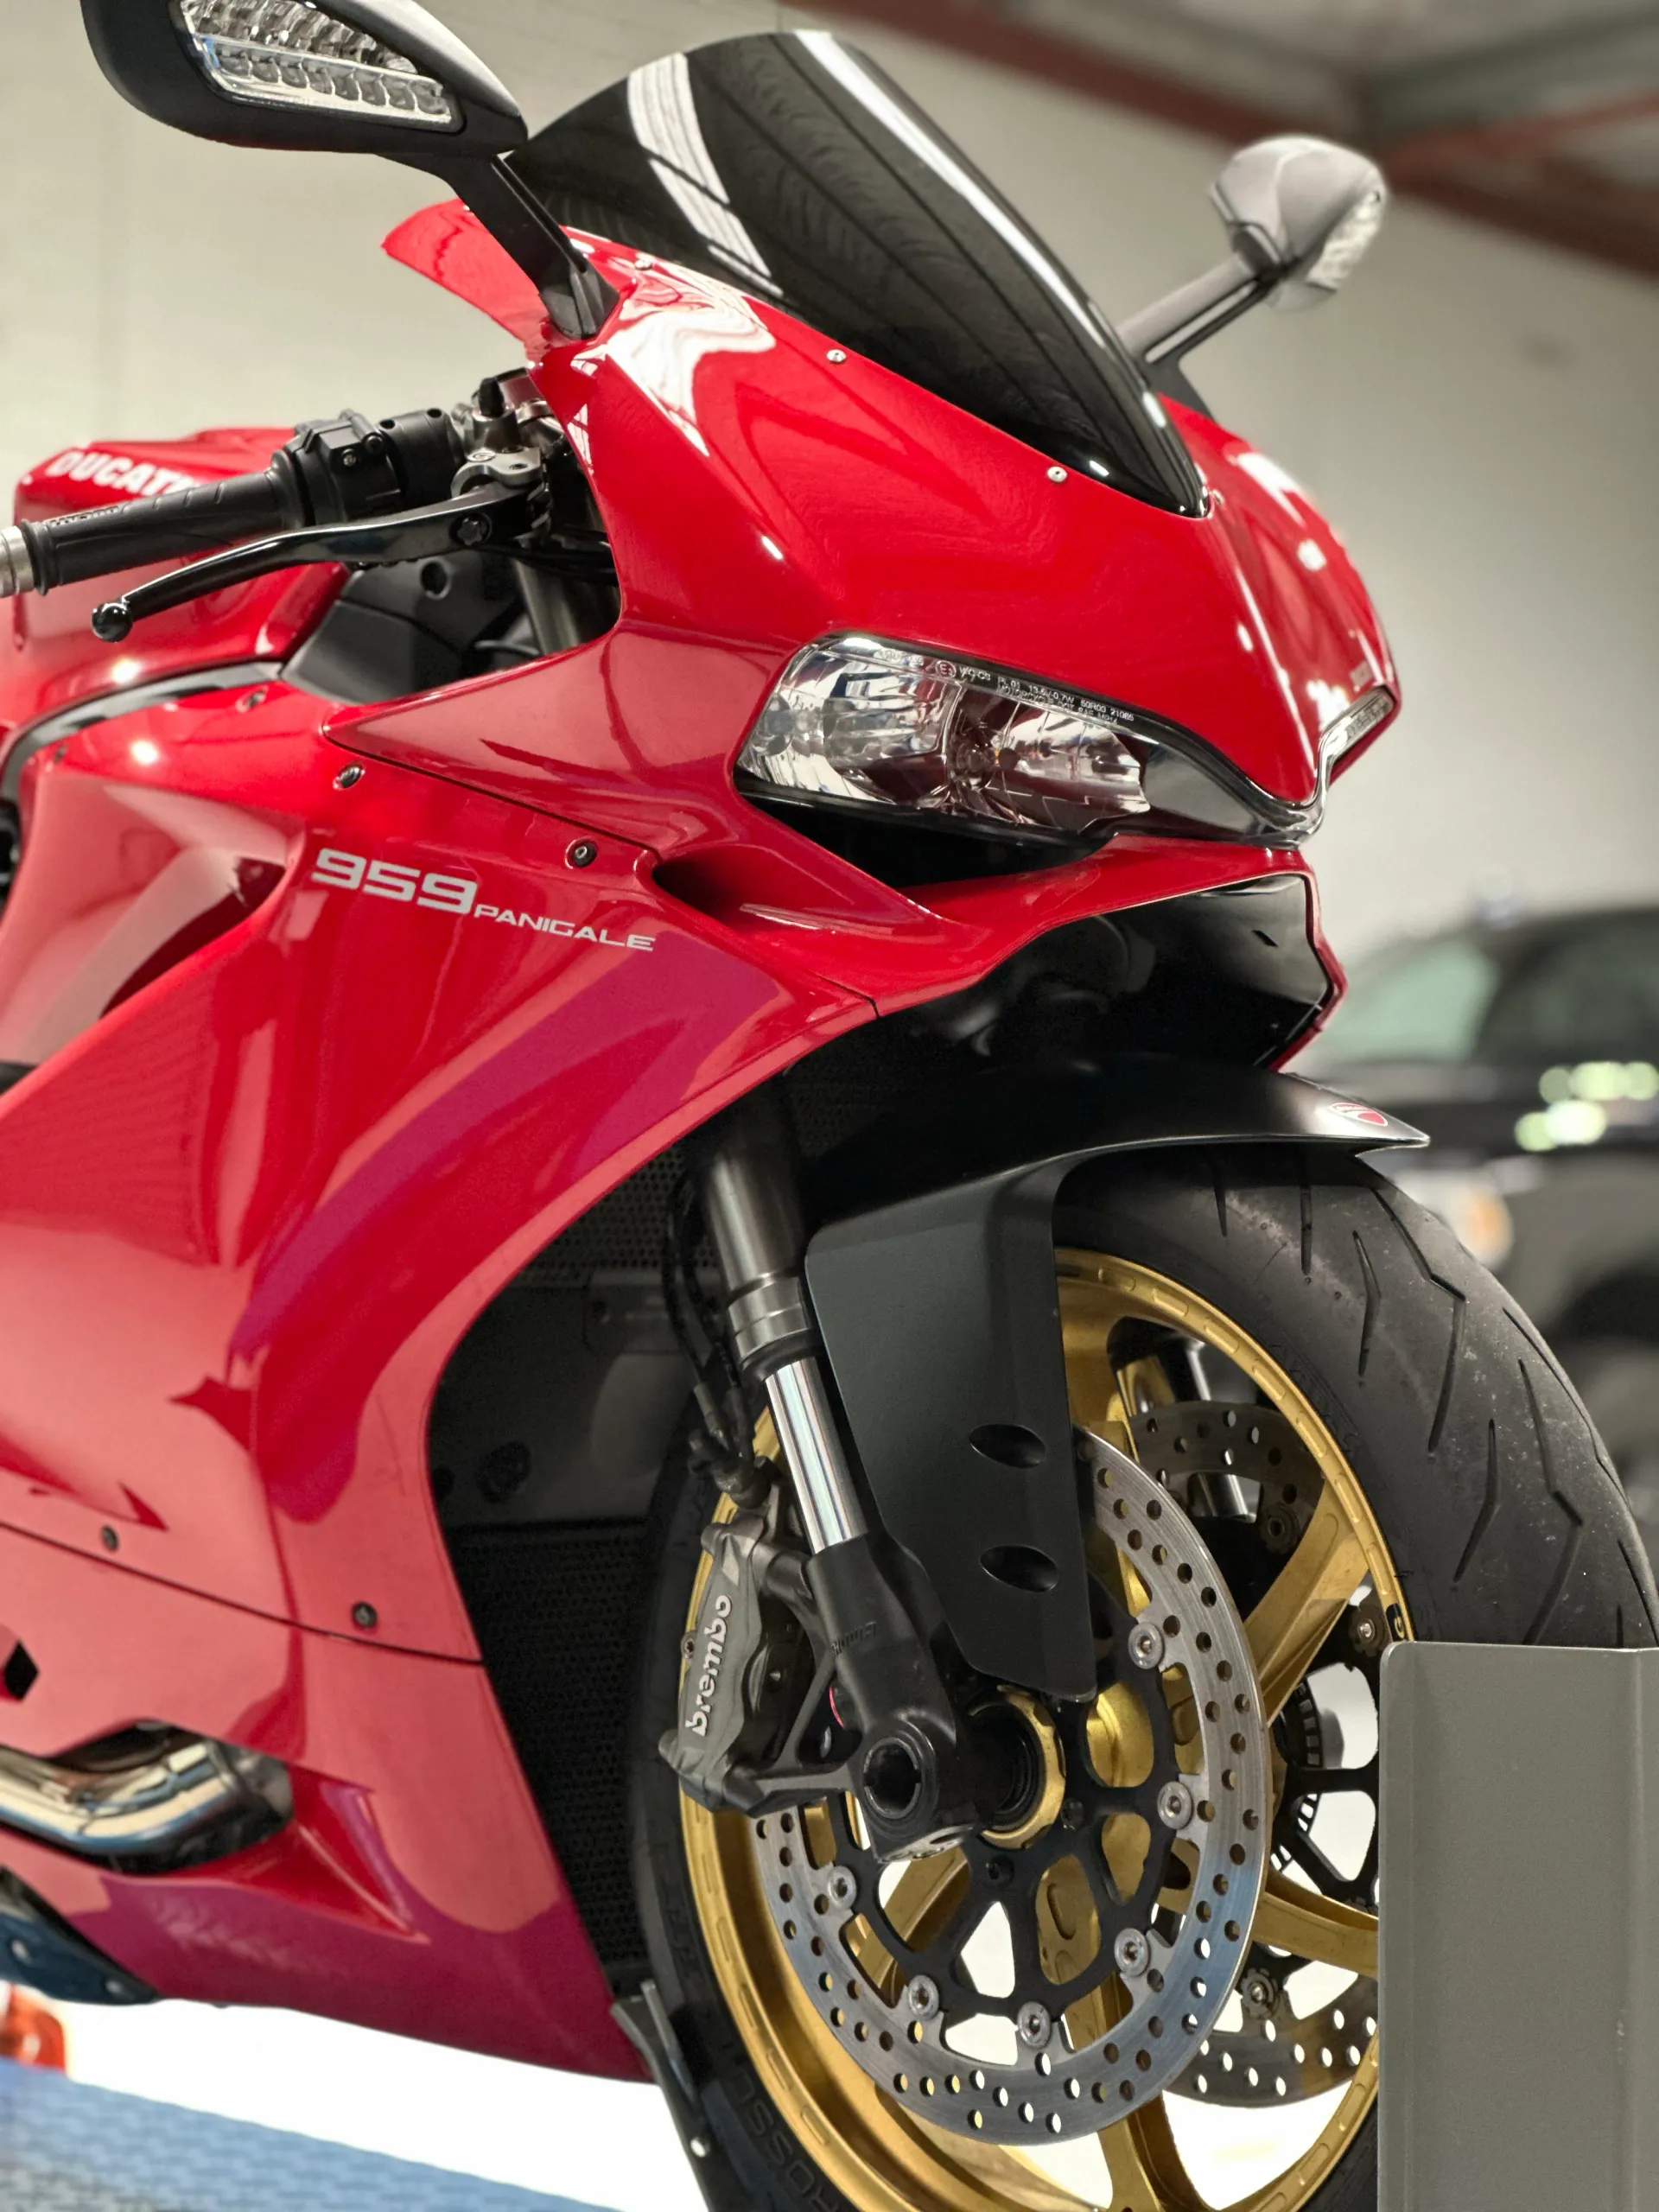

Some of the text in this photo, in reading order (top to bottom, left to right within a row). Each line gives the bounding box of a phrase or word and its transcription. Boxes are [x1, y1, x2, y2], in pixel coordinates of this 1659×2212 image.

[310, 847, 657, 952] 959 PANIGALE
[684, 1593, 732, 1737] brembo
